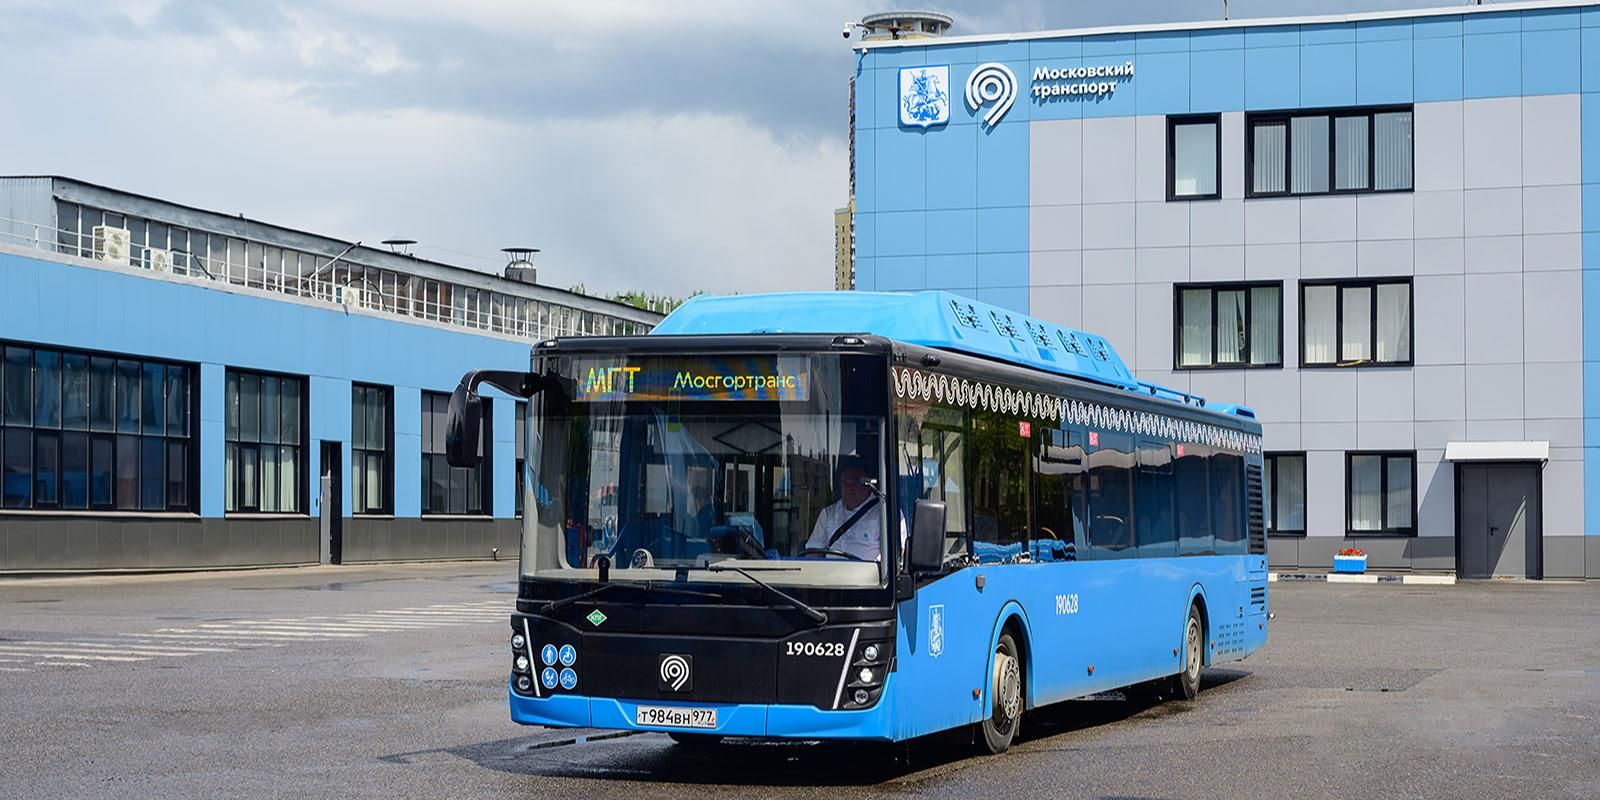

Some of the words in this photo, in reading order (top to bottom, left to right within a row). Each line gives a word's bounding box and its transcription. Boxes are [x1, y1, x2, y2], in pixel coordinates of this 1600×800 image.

[1033, 61, 1134, 81] Московский
[1032, 81, 1117, 99] транспорт
[586, 367, 641, 393] МГТ
[673, 371, 796, 391] Мосгортранс
[1055, 593, 1079, 615] 190628
[786, 641, 845, 656] 190628
[692, 710, 713, 722] 977
